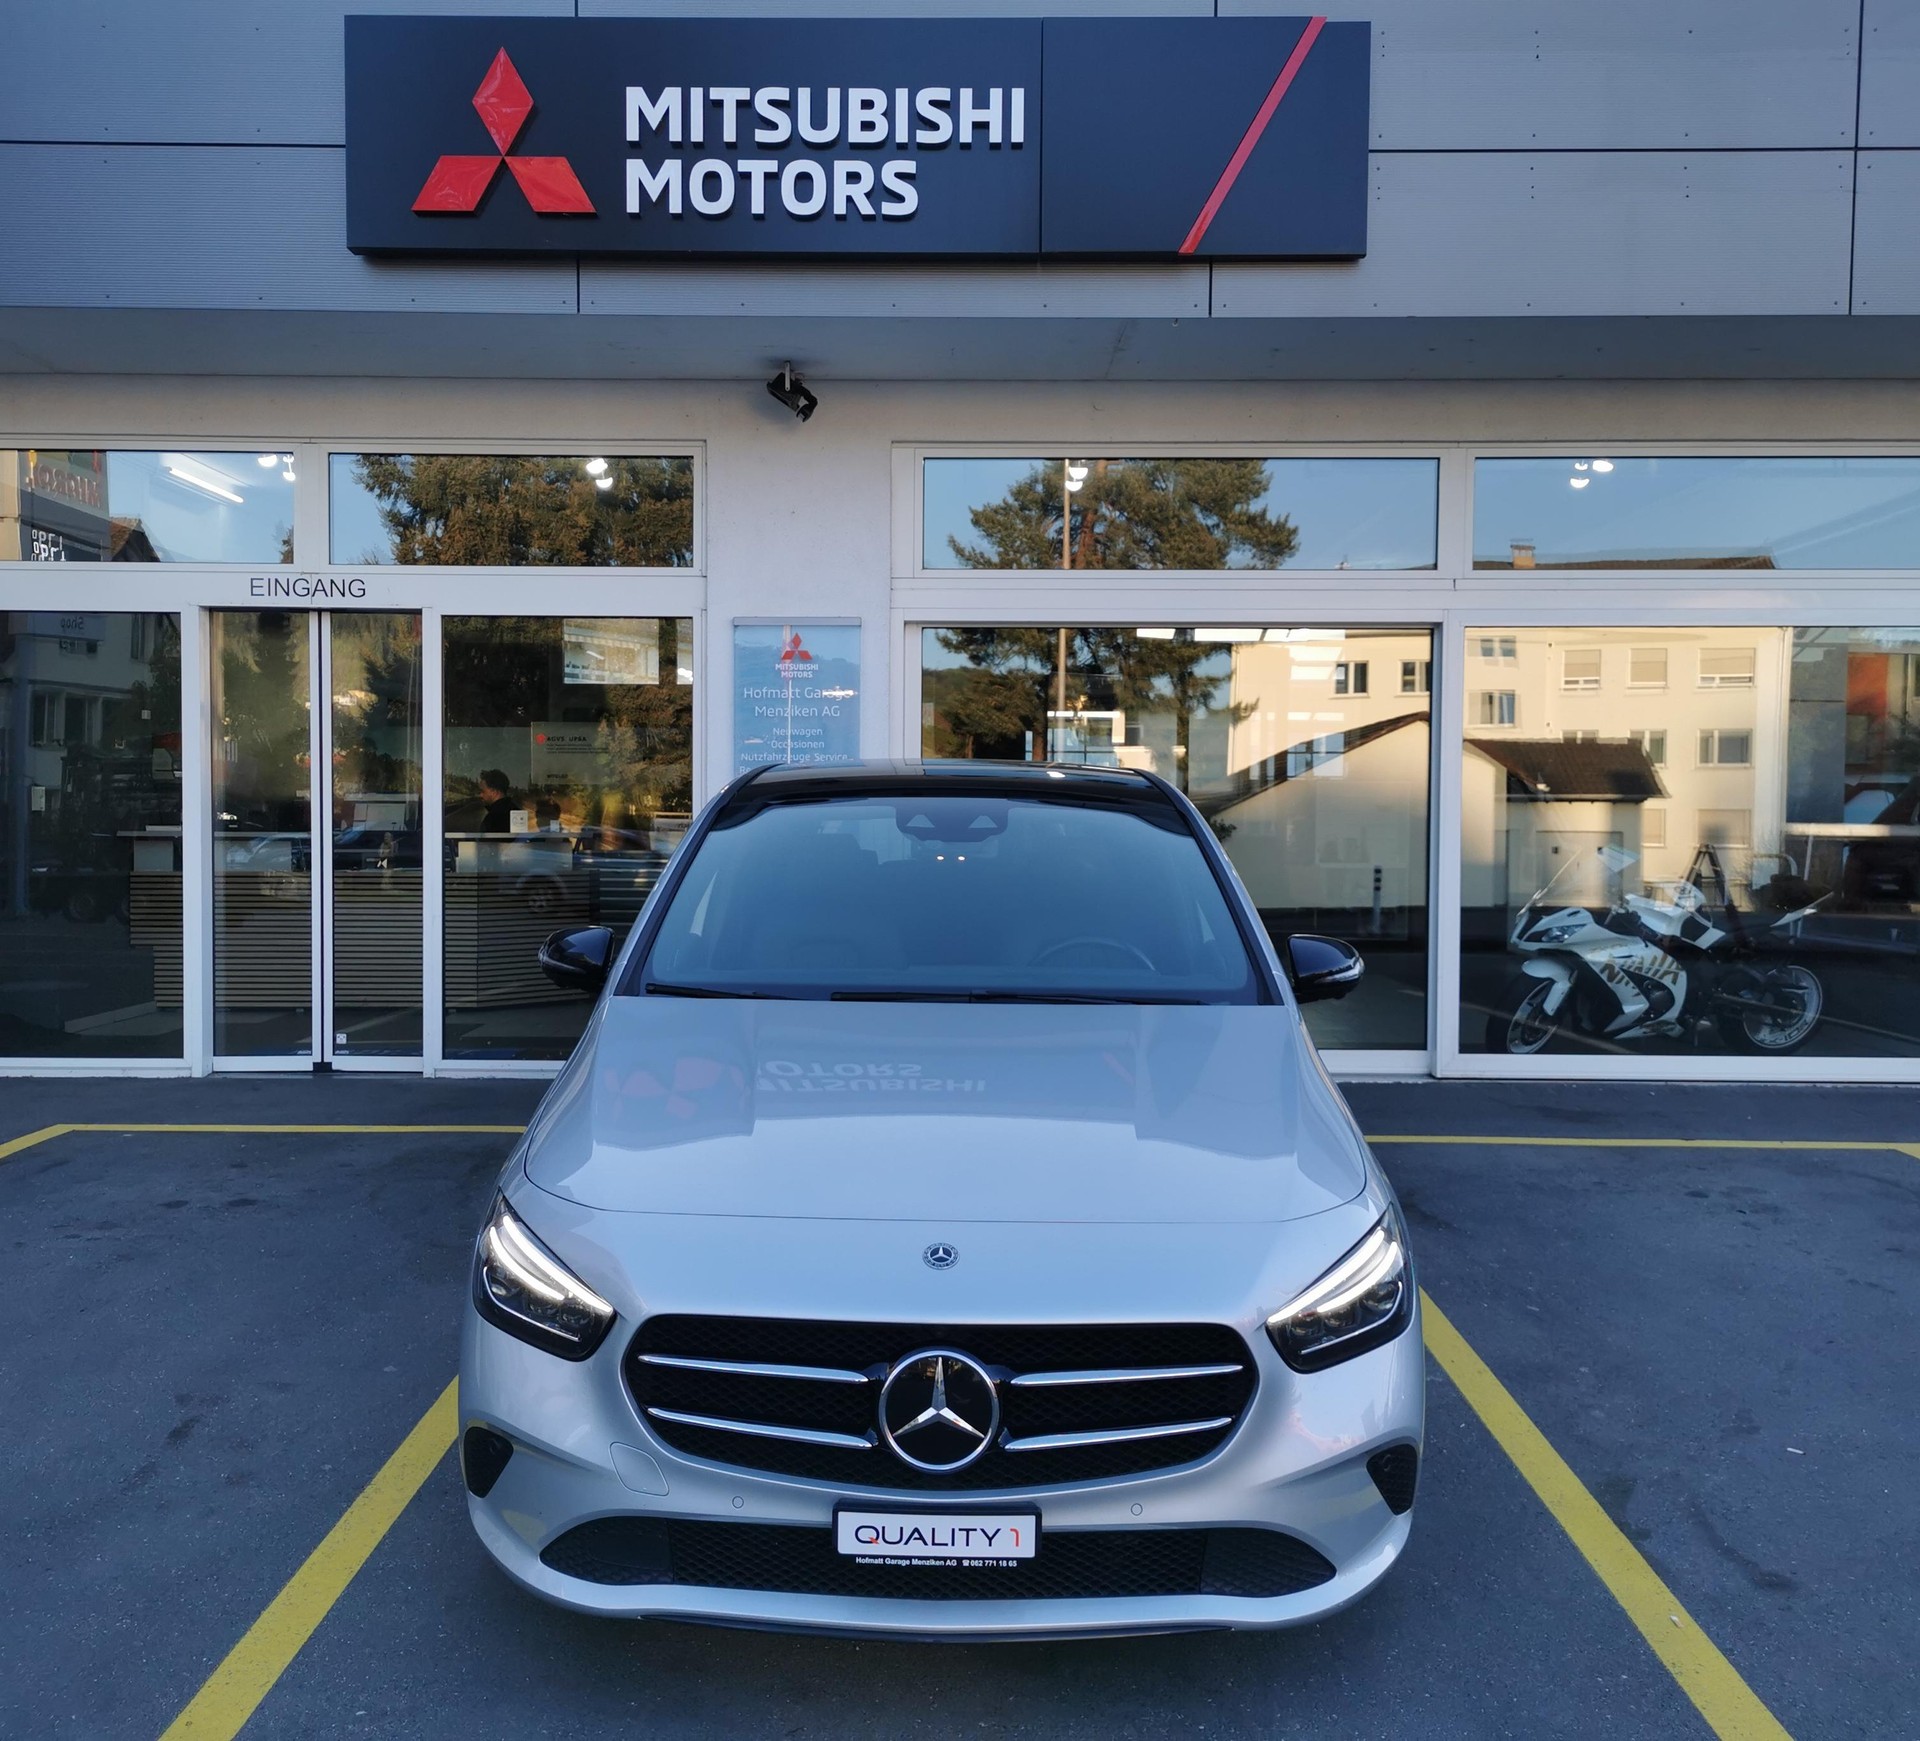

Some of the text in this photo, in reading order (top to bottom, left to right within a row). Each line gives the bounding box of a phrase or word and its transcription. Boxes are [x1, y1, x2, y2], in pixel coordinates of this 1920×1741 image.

[626, 86, 1025, 143] MITSUBISHI
[626, 158, 919, 216] MOTORS
[250, 577, 366, 598] EINGANG
[775, 663, 819, 671] MITSUBISHI
[781, 670, 813, 678] MOTORS
[744, 686, 801, 699] Hofmatt
[755, 705, 840, 717] Menziken AG
[772, 727, 823, 738] Neuwagen
[771, 741, 825, 749] Occasionen
[741, 753, 810, 763] Nutzfahrzeuge
[854, 1525, 1020, 1547] QUALITY 1
[855, 1556, 884, 1564] Hofmatt
[885, 1557, 910, 1567] Garage
[911, 1558, 945, 1567] Menziken
[945, 1559, 957, 1567] AG
[984, 1559, 997, 1567] 771
